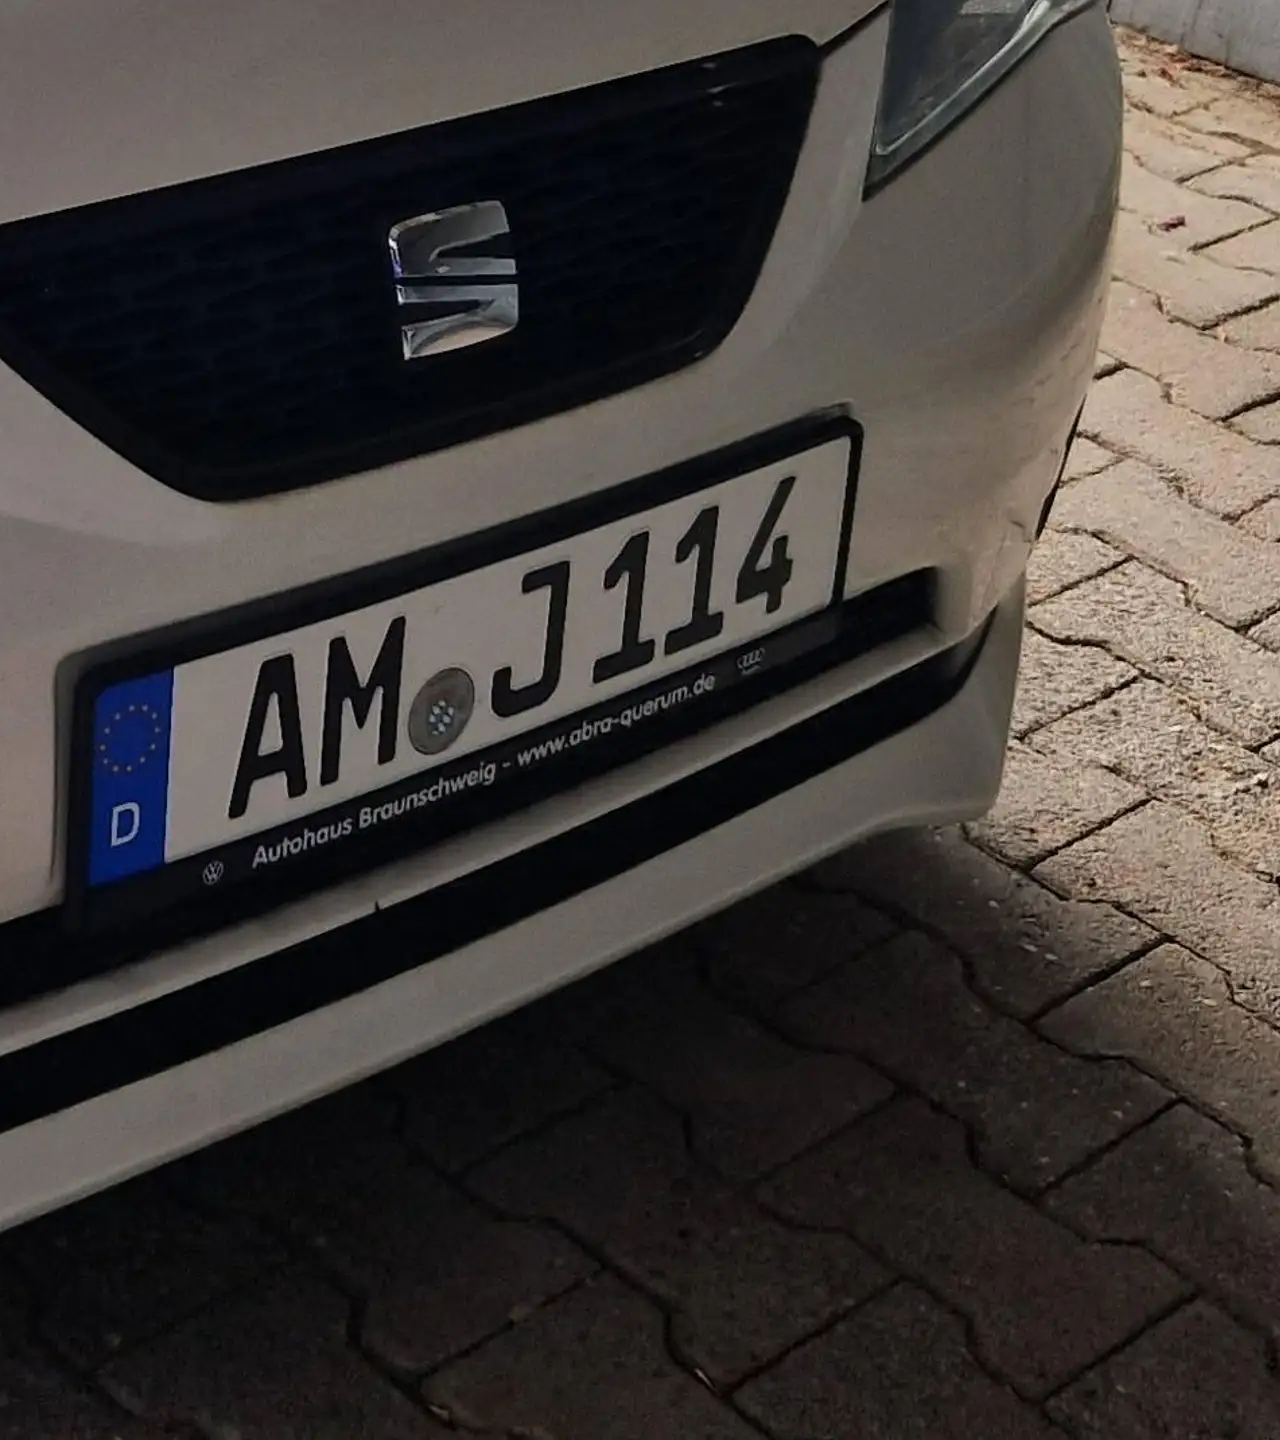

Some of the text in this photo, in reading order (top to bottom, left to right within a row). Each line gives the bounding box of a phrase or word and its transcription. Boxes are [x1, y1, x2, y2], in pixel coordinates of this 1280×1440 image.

[227, 616, 406, 819] AM
[252, 816, 354, 868] Autohaus
[358, 761, 497, 830] Braunschweig
[516, 672, 716, 767] www.abra-querum.de
[110, 802, 140, 849] D
